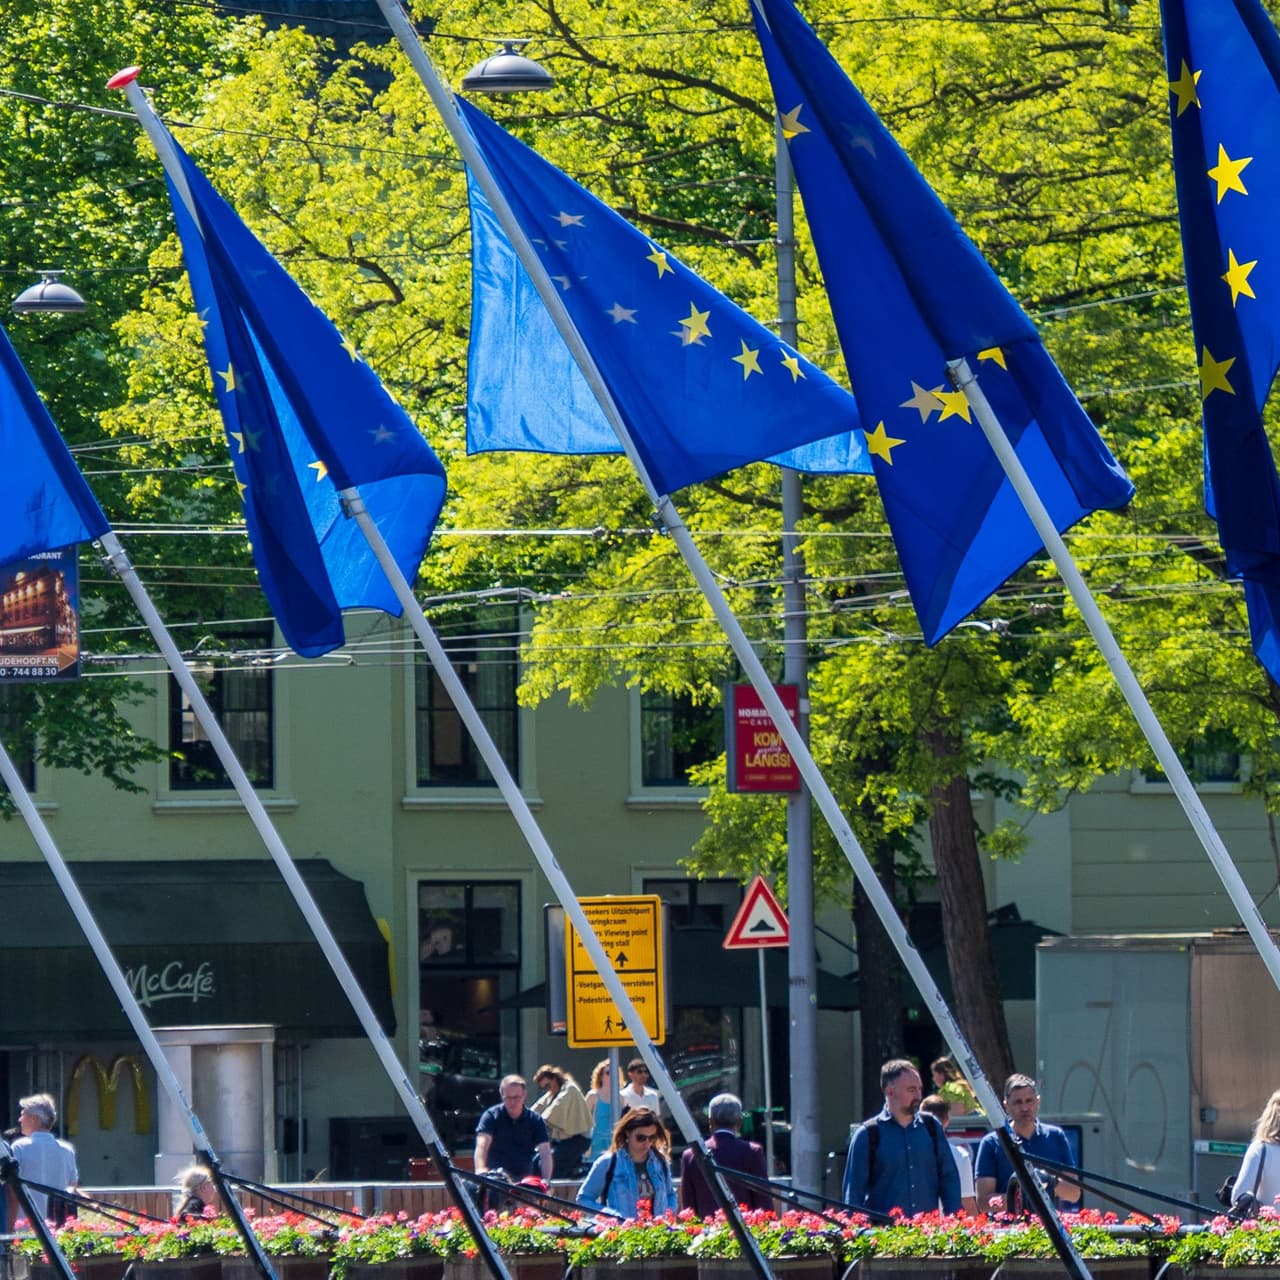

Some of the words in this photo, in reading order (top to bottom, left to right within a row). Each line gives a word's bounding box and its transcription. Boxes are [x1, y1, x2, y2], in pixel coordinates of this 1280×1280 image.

[28, 552, 62, 560] AURANT
[0, 657, 58, 665] UDEHOOFT.NL
[12, 668, 29, 676] 744
[32, 667, 43, 676] 88
[45, 667, 57, 676] 30
[753, 732, 782, 747] KOM
[745, 753, 791, 768] LANGS!
